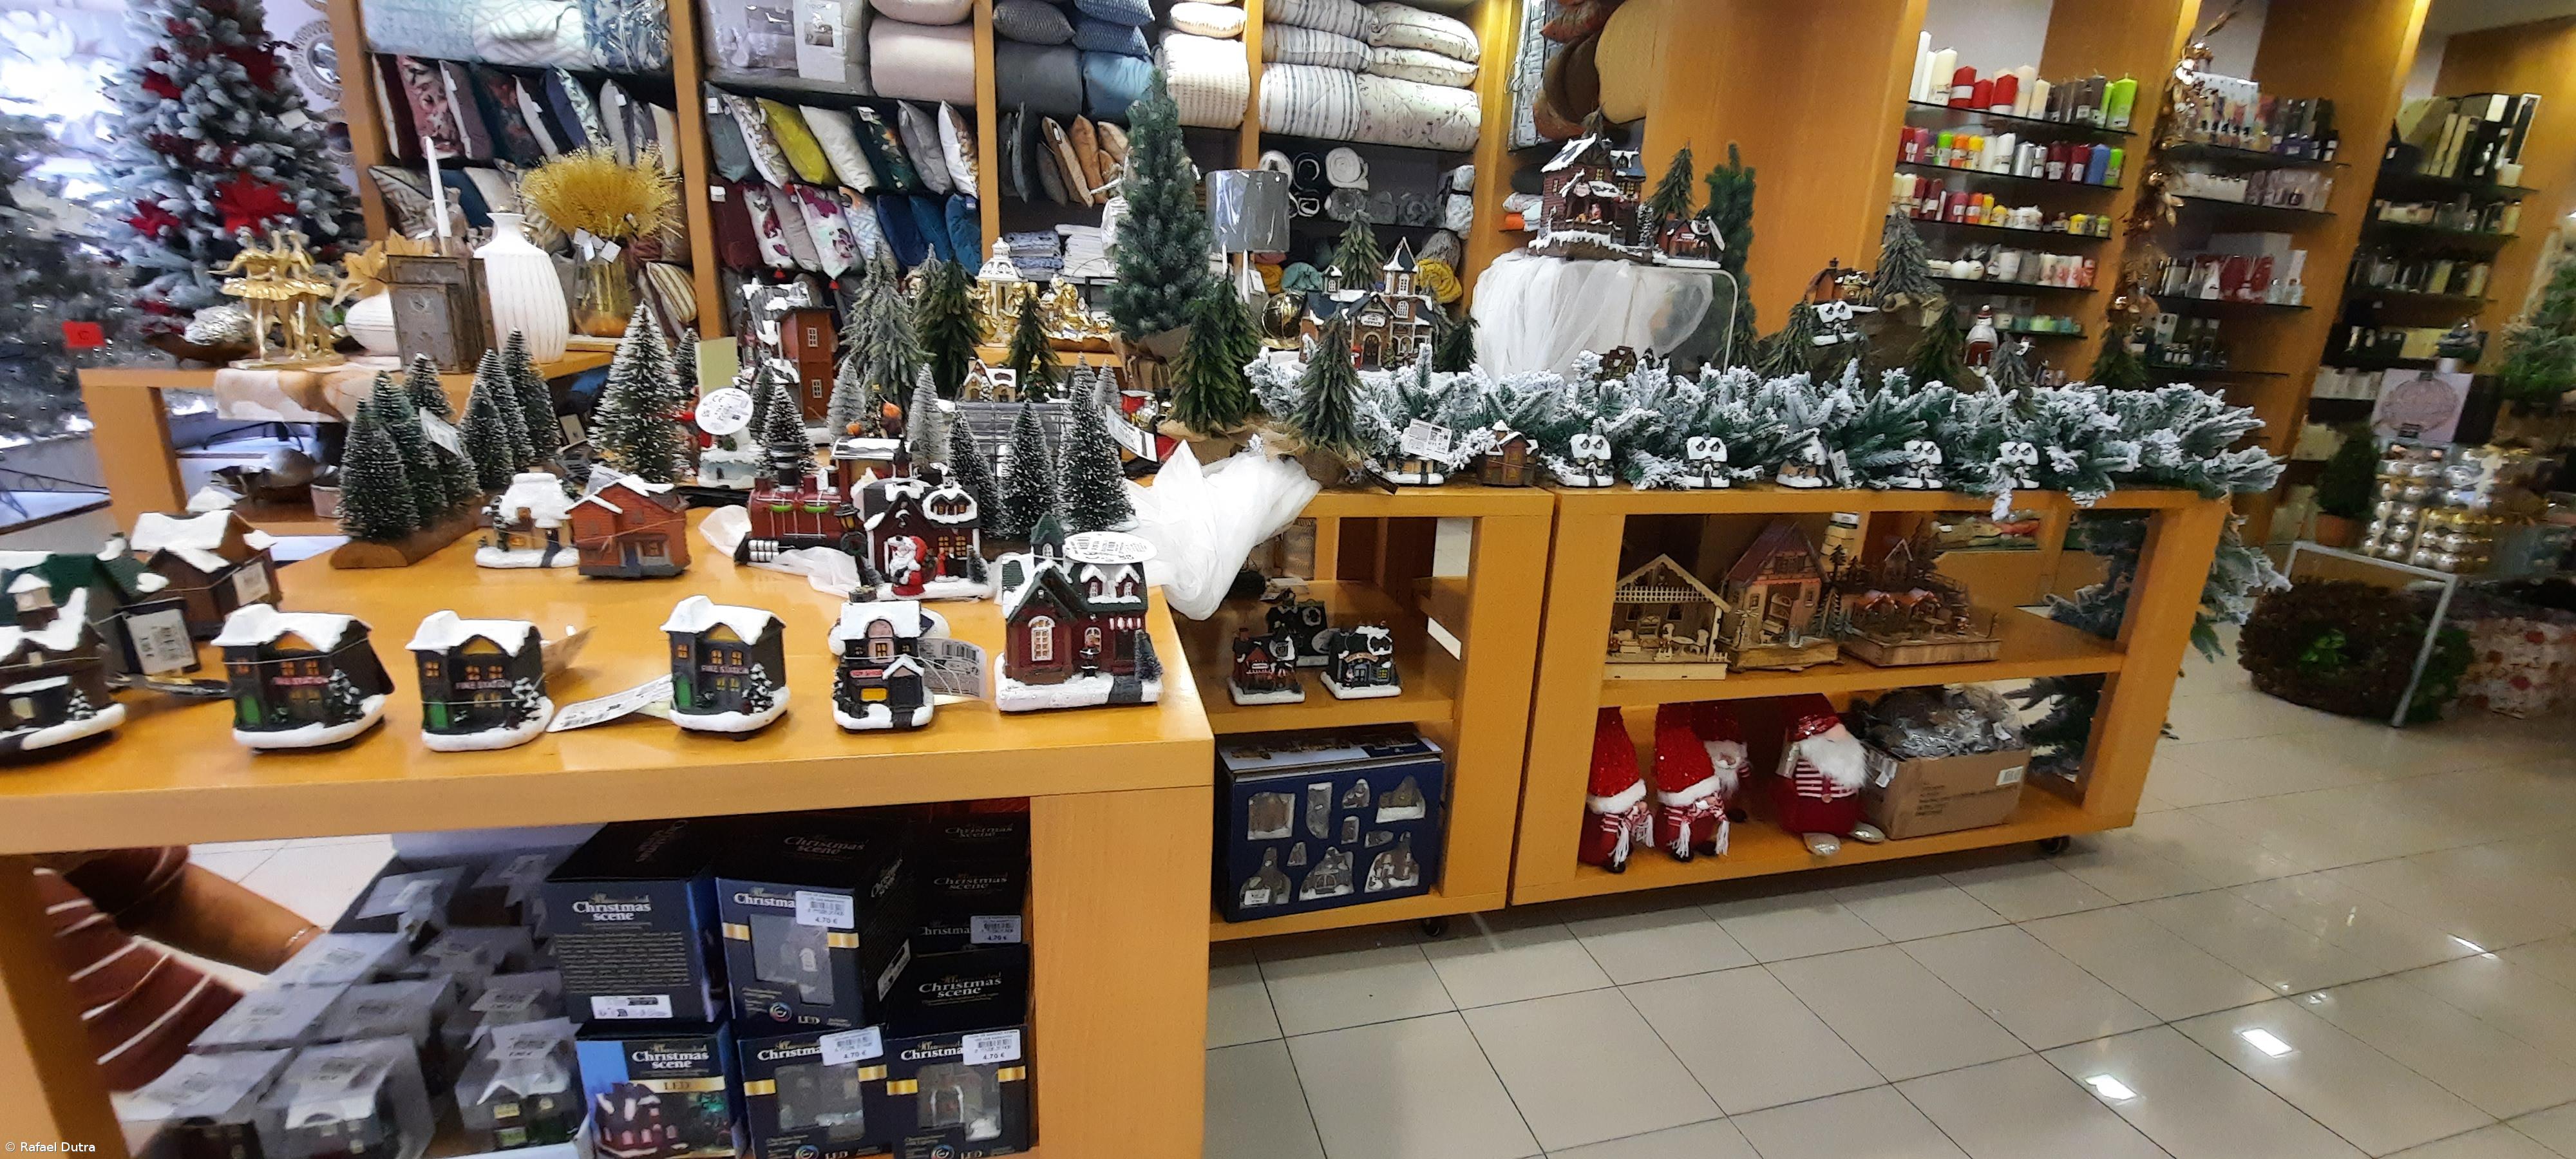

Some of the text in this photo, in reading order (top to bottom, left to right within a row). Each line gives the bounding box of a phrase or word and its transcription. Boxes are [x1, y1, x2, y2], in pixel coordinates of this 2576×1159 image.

[734, 892, 796, 909] Christma
[572, 901, 652, 913] Christmas
[592, 912, 634, 921] scene
[918, 978, 1002, 993] Christmas
[937, 986, 981, 999] scene
[632, 1050, 710, 1062] Christmas
[757, 1045, 822, 1061] Christma
[900, 1046, 963, 1061] Christma
[652, 1060, 692, 1069] scene
[664, 1082, 690, 1090] LED
